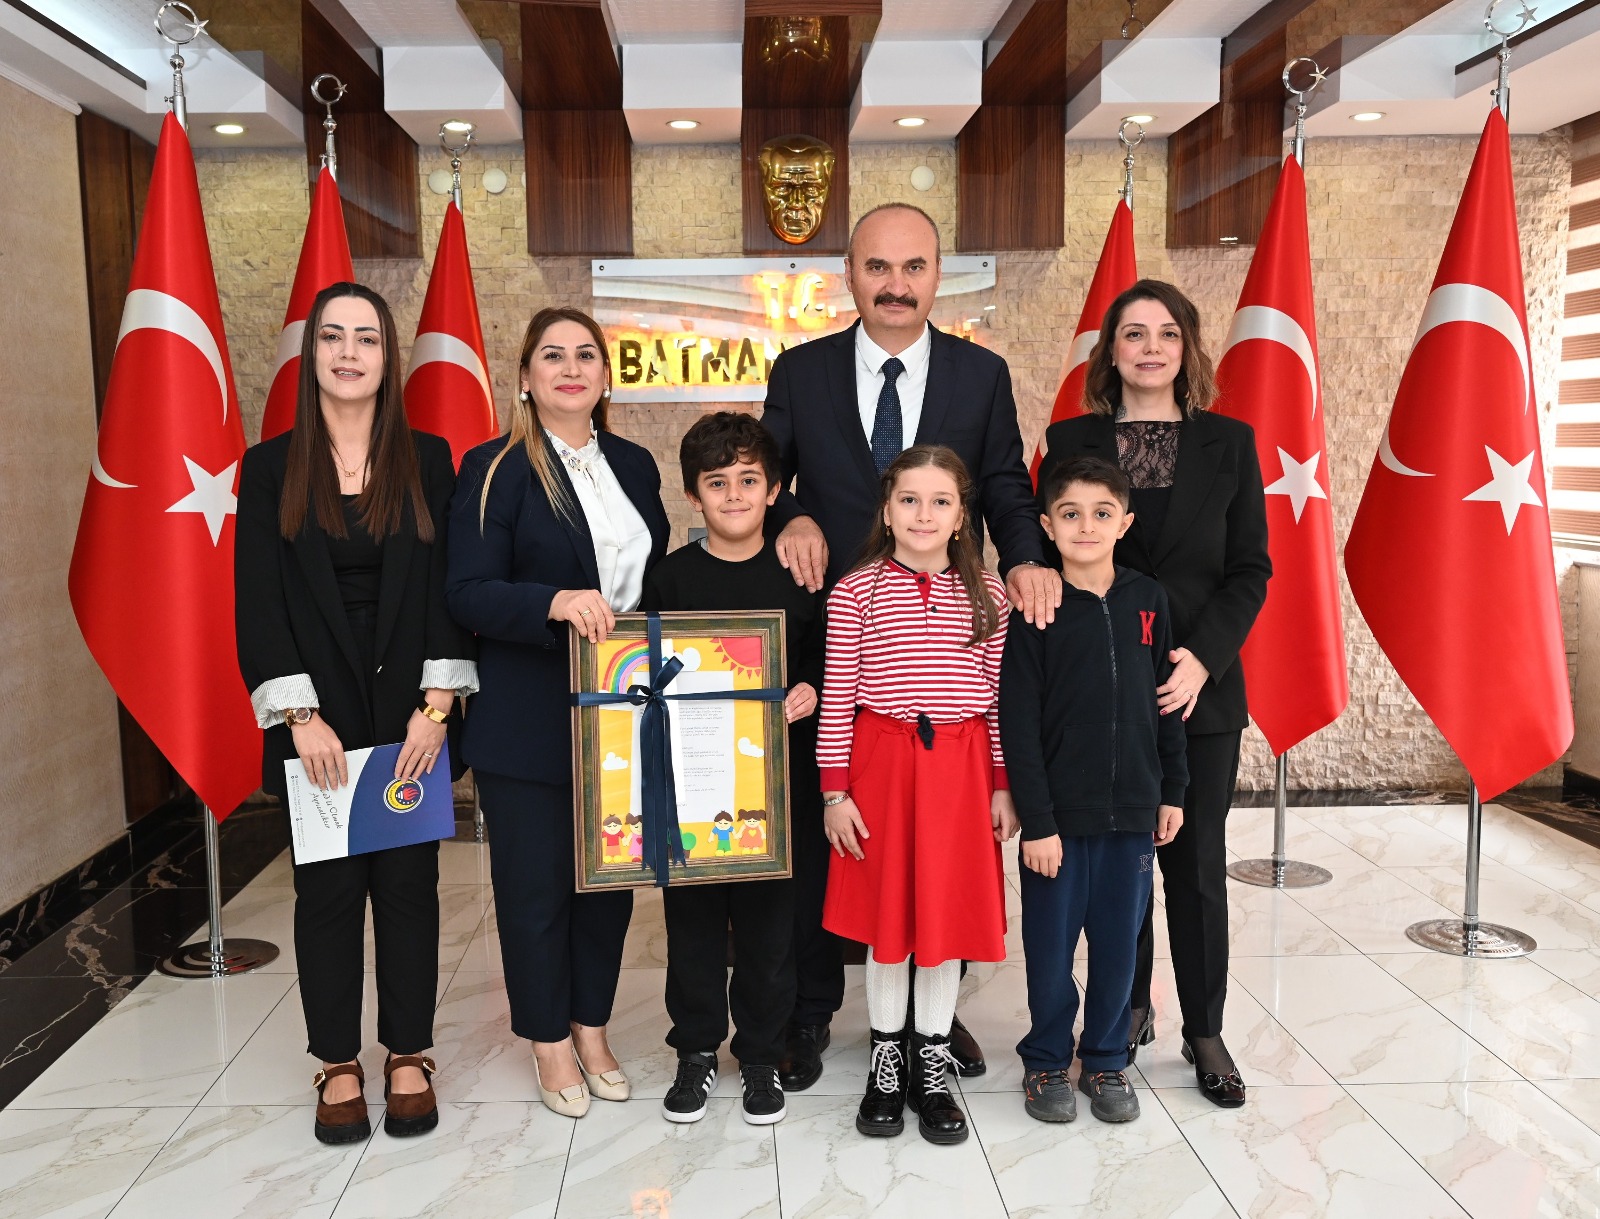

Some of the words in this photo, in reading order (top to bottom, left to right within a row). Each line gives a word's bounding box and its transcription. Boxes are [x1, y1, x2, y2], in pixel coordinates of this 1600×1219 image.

[761, 272, 837, 319] T.C.
[1139, 610, 1156, 646] K
[1139, 853, 1153, 873] K
